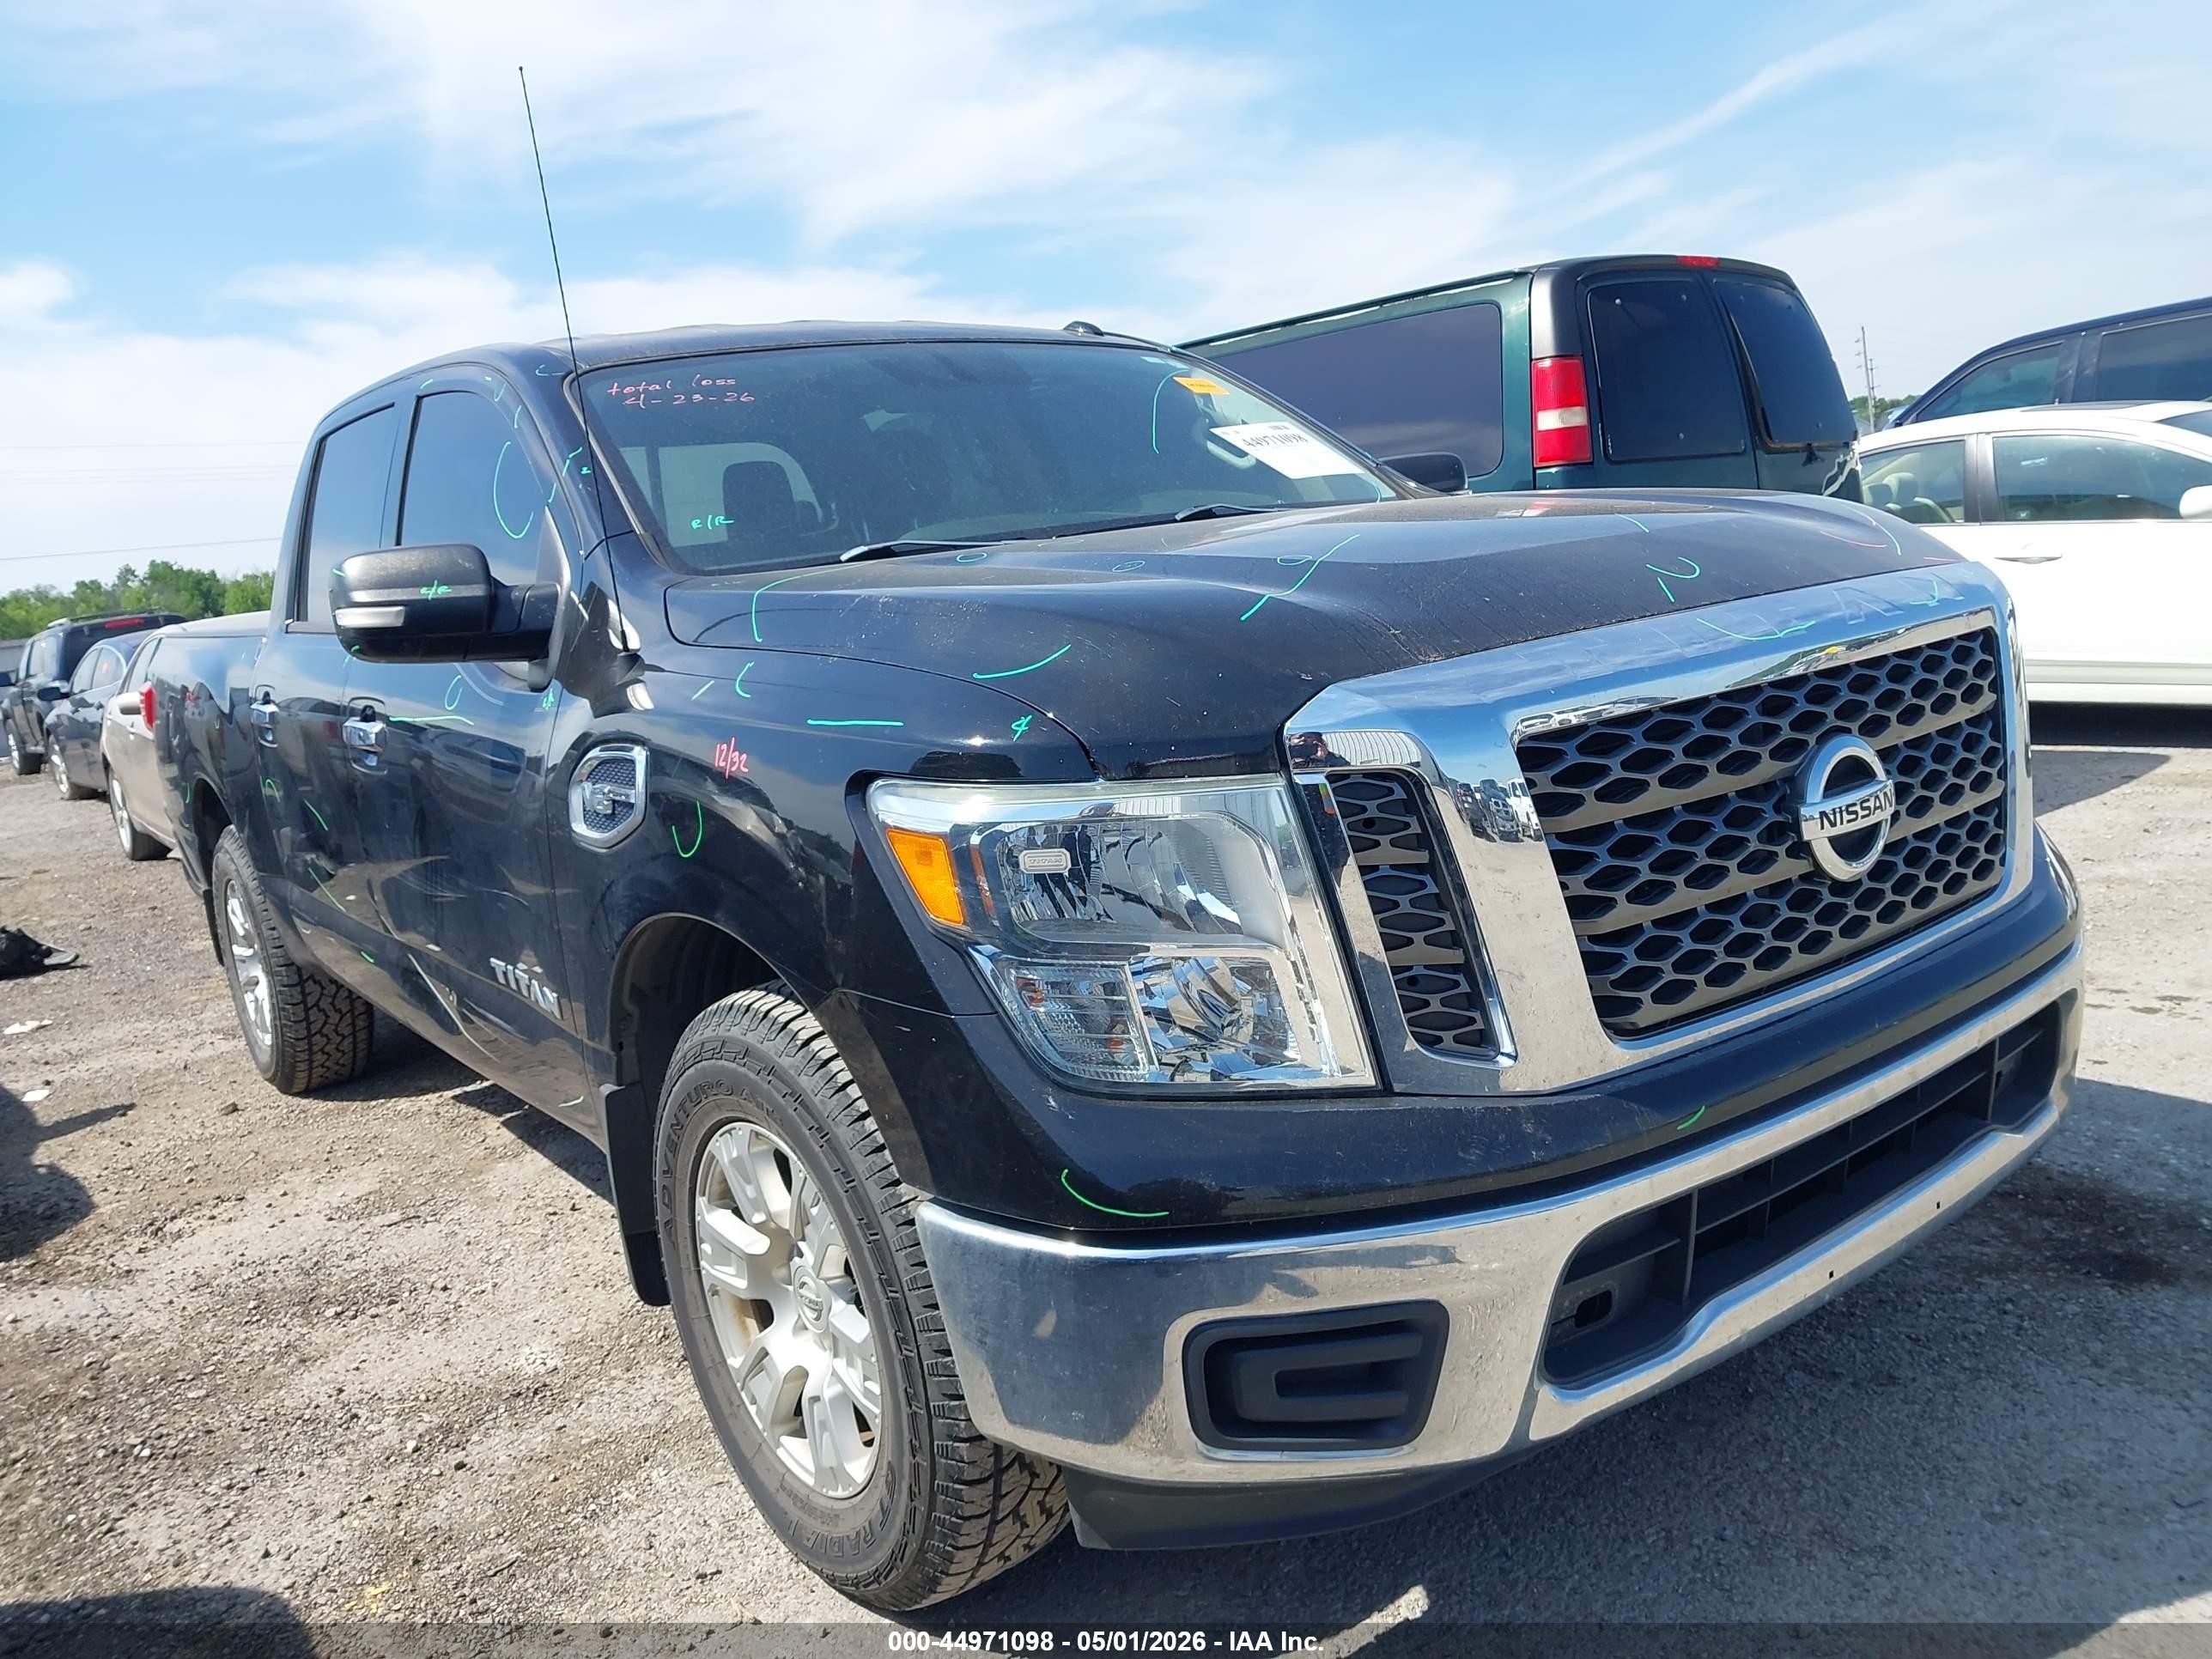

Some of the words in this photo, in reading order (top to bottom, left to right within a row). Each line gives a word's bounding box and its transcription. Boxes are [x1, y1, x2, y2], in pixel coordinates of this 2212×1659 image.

[607, 380, 673, 397] total
[691, 374, 737, 387] loss
[1819, 787, 1894, 831] NISSAN
[489, 957, 564, 1020] TITAN
